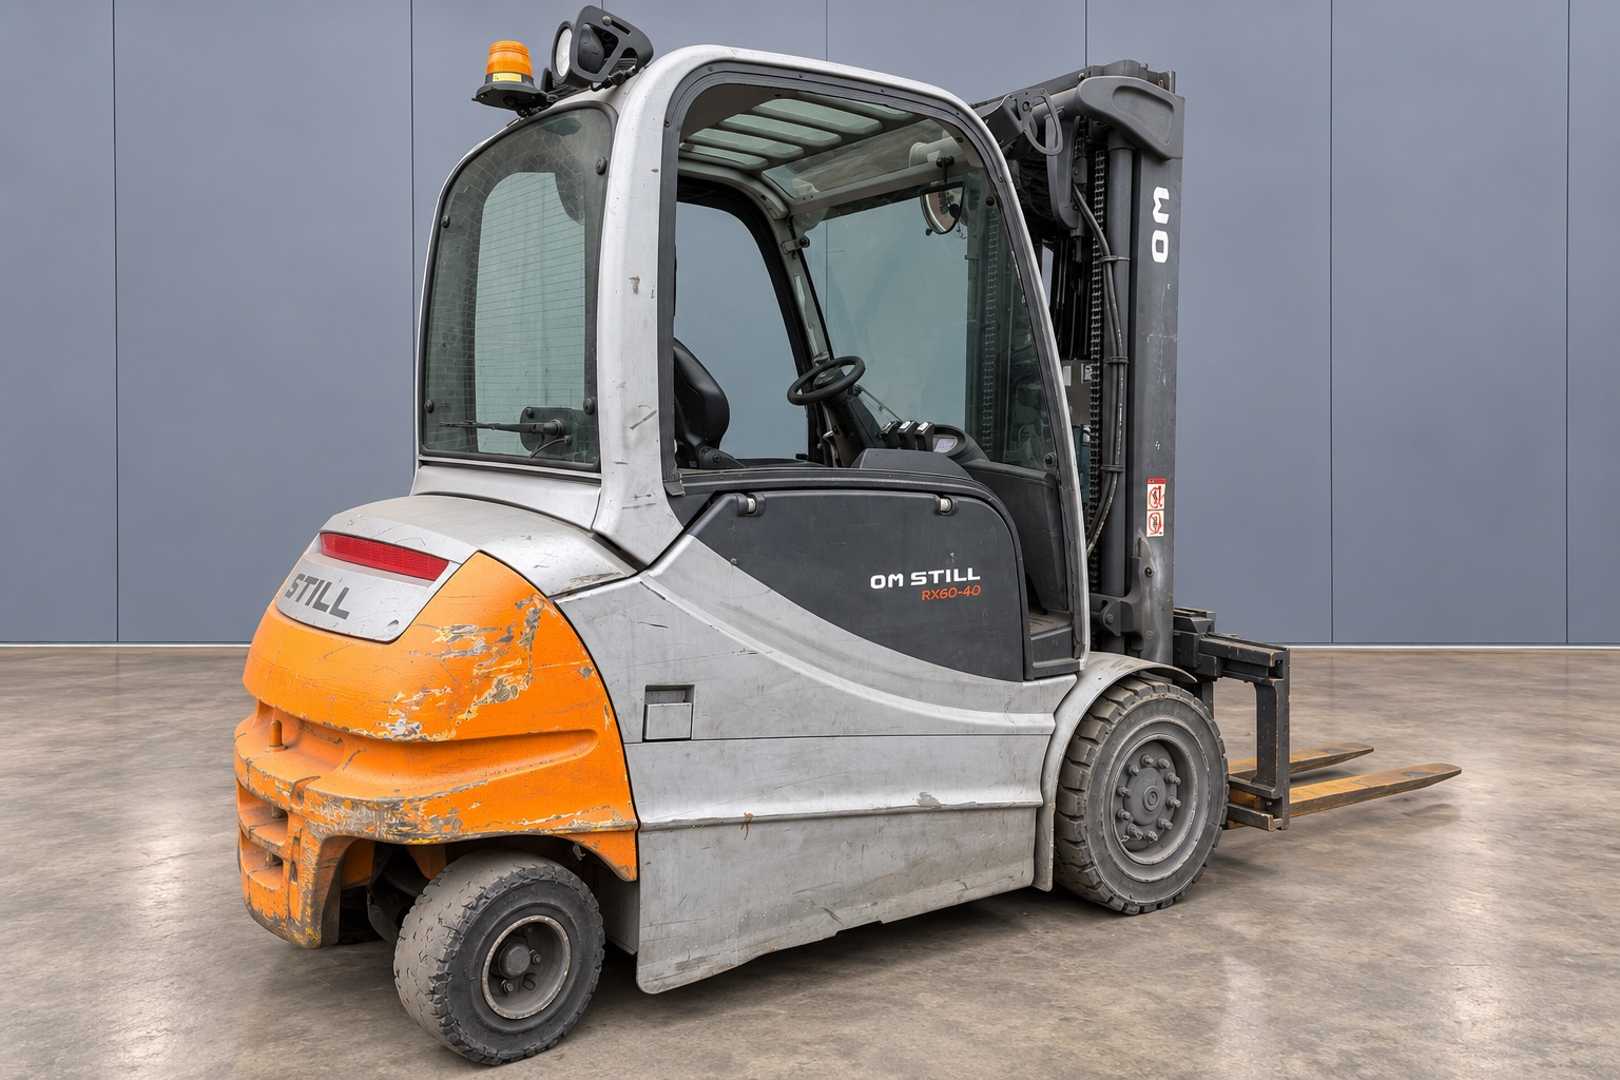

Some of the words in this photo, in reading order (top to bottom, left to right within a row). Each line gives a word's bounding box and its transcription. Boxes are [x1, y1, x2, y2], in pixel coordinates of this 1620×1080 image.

[1151, 186, 1170, 263] OM
[870, 573, 904, 589] OM
[910, 567, 981, 586] STILL
[921, 585, 981, 601] RX60-40
[285, 573, 350, 620] STILL
